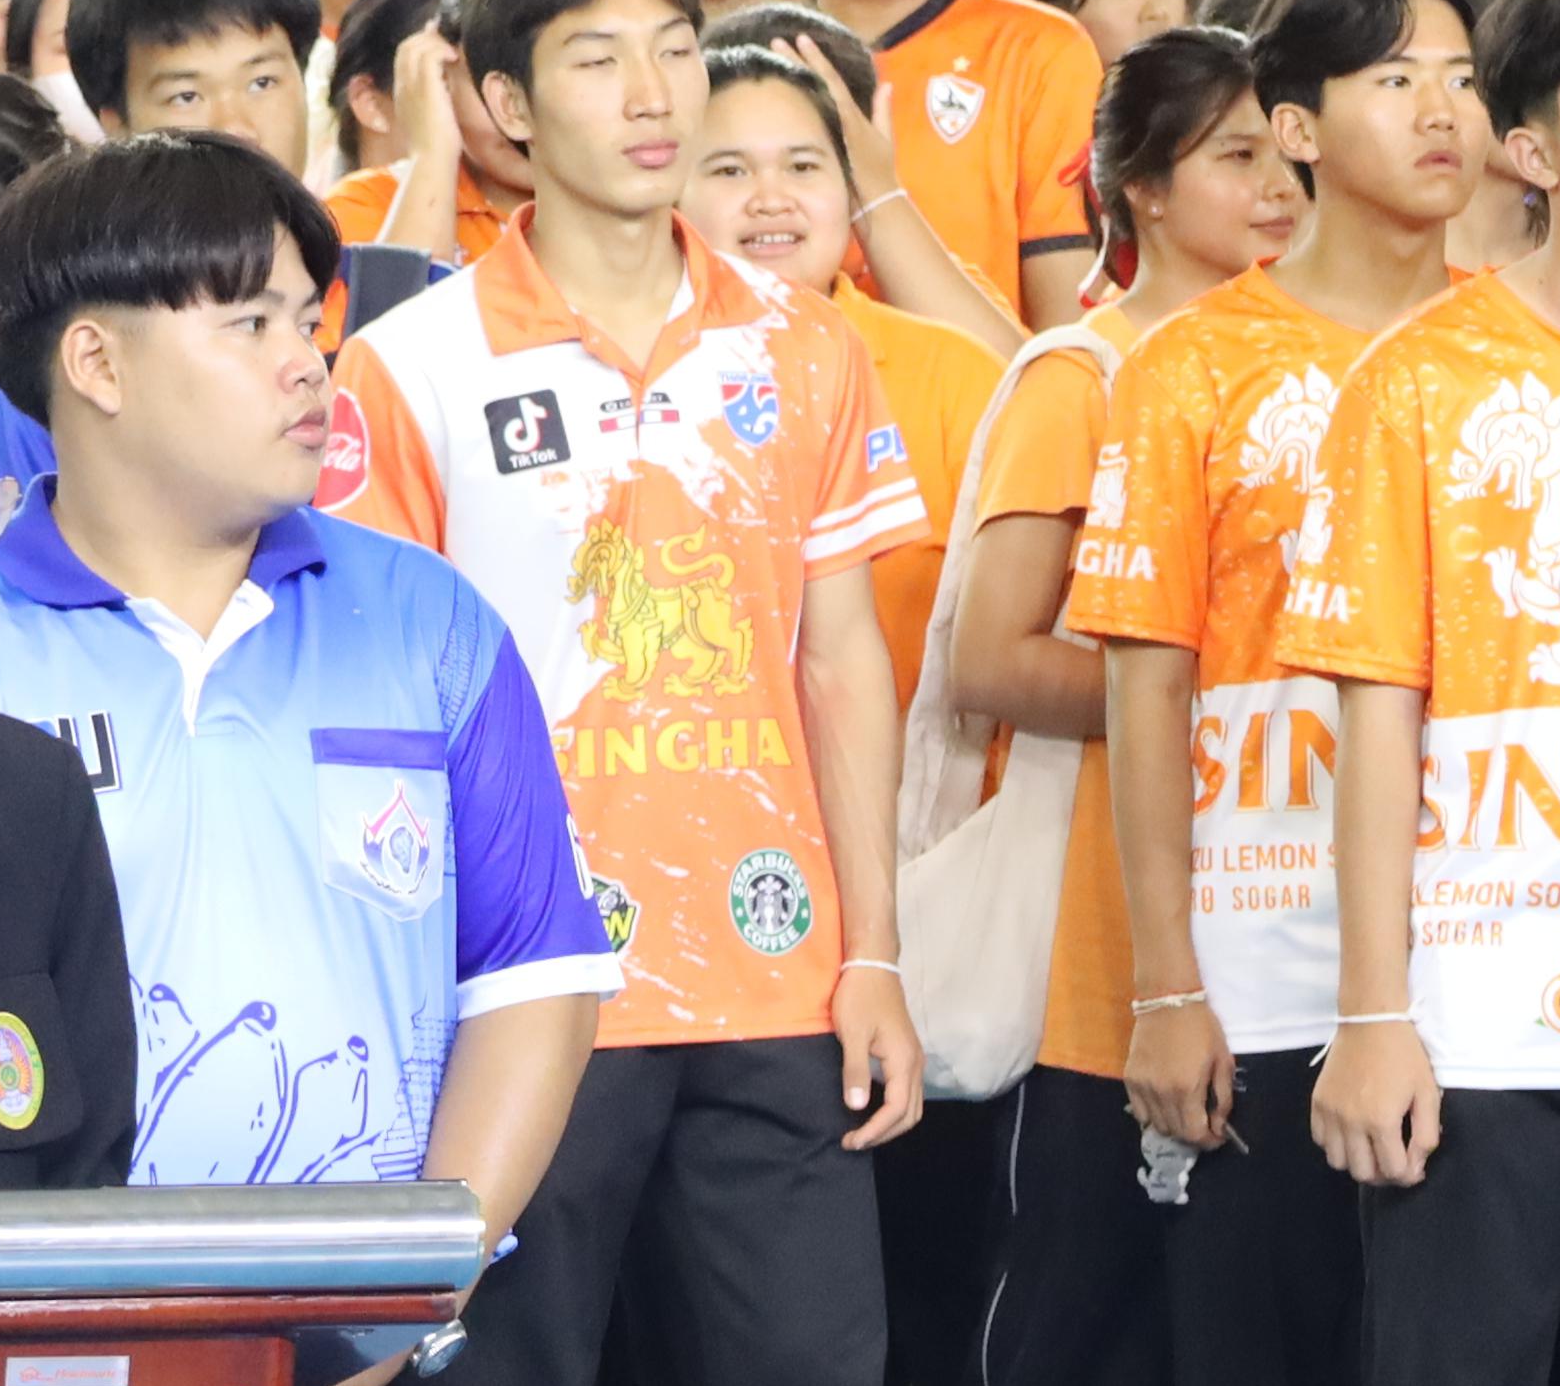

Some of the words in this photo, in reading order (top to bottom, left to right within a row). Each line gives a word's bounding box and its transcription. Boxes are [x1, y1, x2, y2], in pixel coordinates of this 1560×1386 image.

[509, 448, 558, 469] TikTok
[1224, 843, 1316, 873] LEMON
[732, 853, 807, 900] STARBUCKS
[1415, 880, 1516, 908] LEMON
[743, 923, 801, 952] COFFEE
